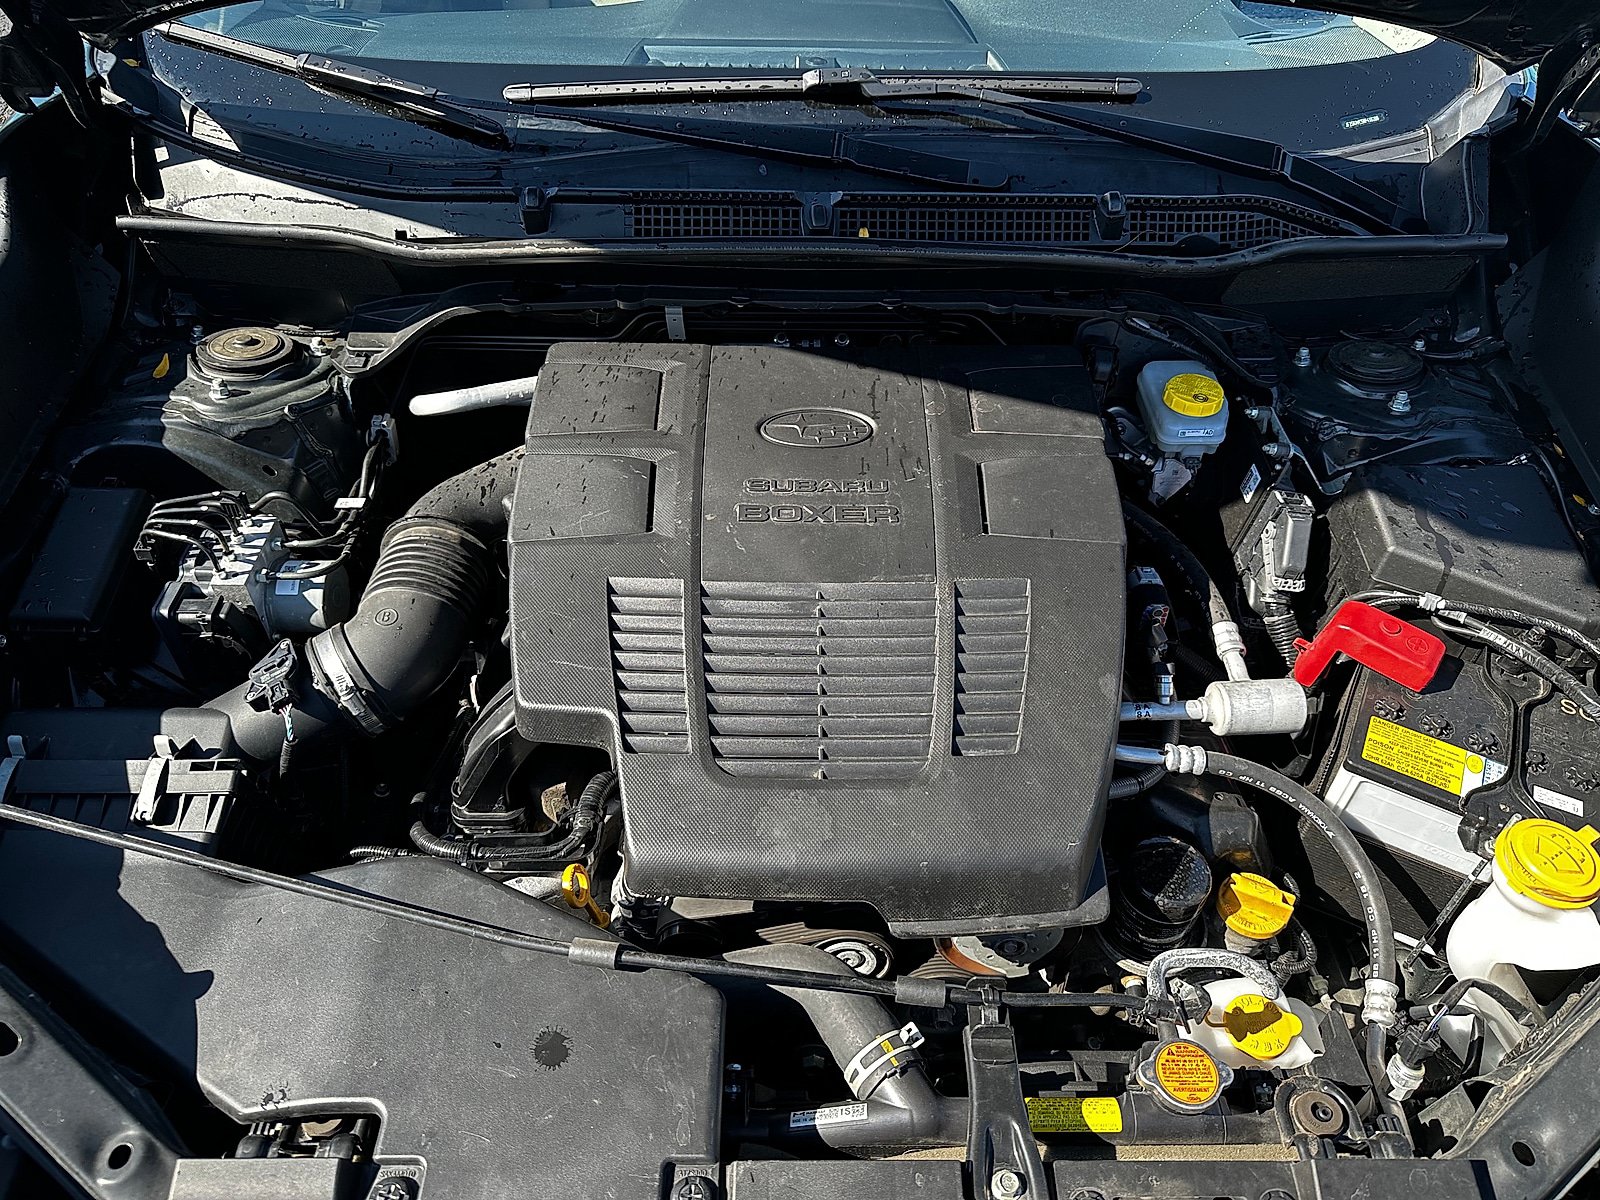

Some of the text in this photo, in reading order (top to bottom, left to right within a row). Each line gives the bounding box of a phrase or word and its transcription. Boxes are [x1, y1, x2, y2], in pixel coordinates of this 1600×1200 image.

[743, 478, 890, 494] SUBARU
[734, 503, 900, 524] BOXER
[382, 611, 391, 622] B
[1372, 717, 1399, 732] DANGER
[1367, 737, 1394, 751] POISON
[1396, 764, 1409, 773] CCA
[1256, 779, 1265, 788] 11
[1298, 803, 1336, 838] YOKOHAMA
[1372, 930, 1378, 943] HP
[1372, 948, 1380, 958] 11
